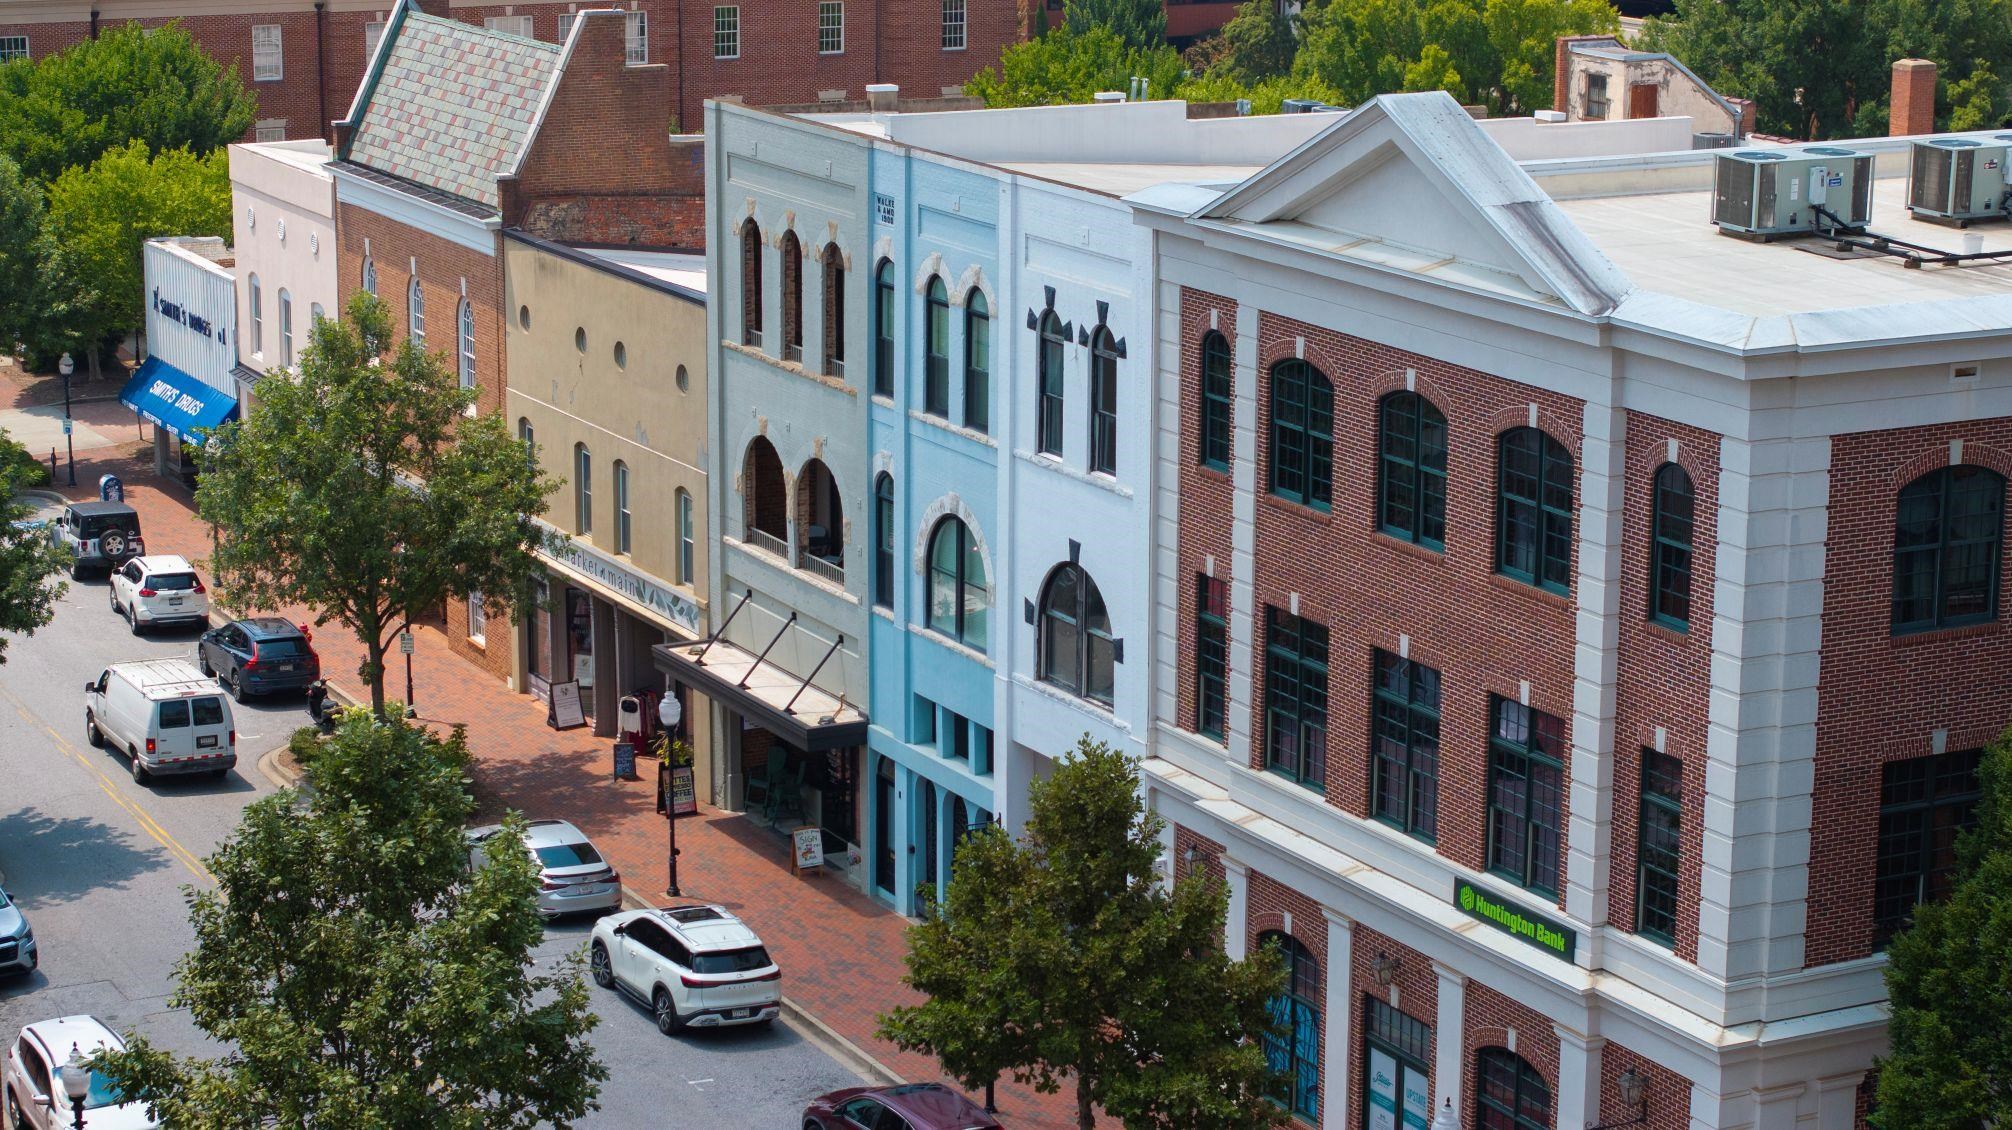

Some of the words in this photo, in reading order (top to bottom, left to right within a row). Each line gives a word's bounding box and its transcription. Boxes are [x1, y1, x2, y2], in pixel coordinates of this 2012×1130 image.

[188, 312, 211, 338] DRUGS
[149, 379, 180, 403] SMITH'S
[174, 393, 204, 416] DRUGS
[608, 570, 635, 596] main
[665, 789, 692, 798] CFFEE
[1475, 894, 1535, 938] Huntington
[1536, 923, 1565, 952] Bank
